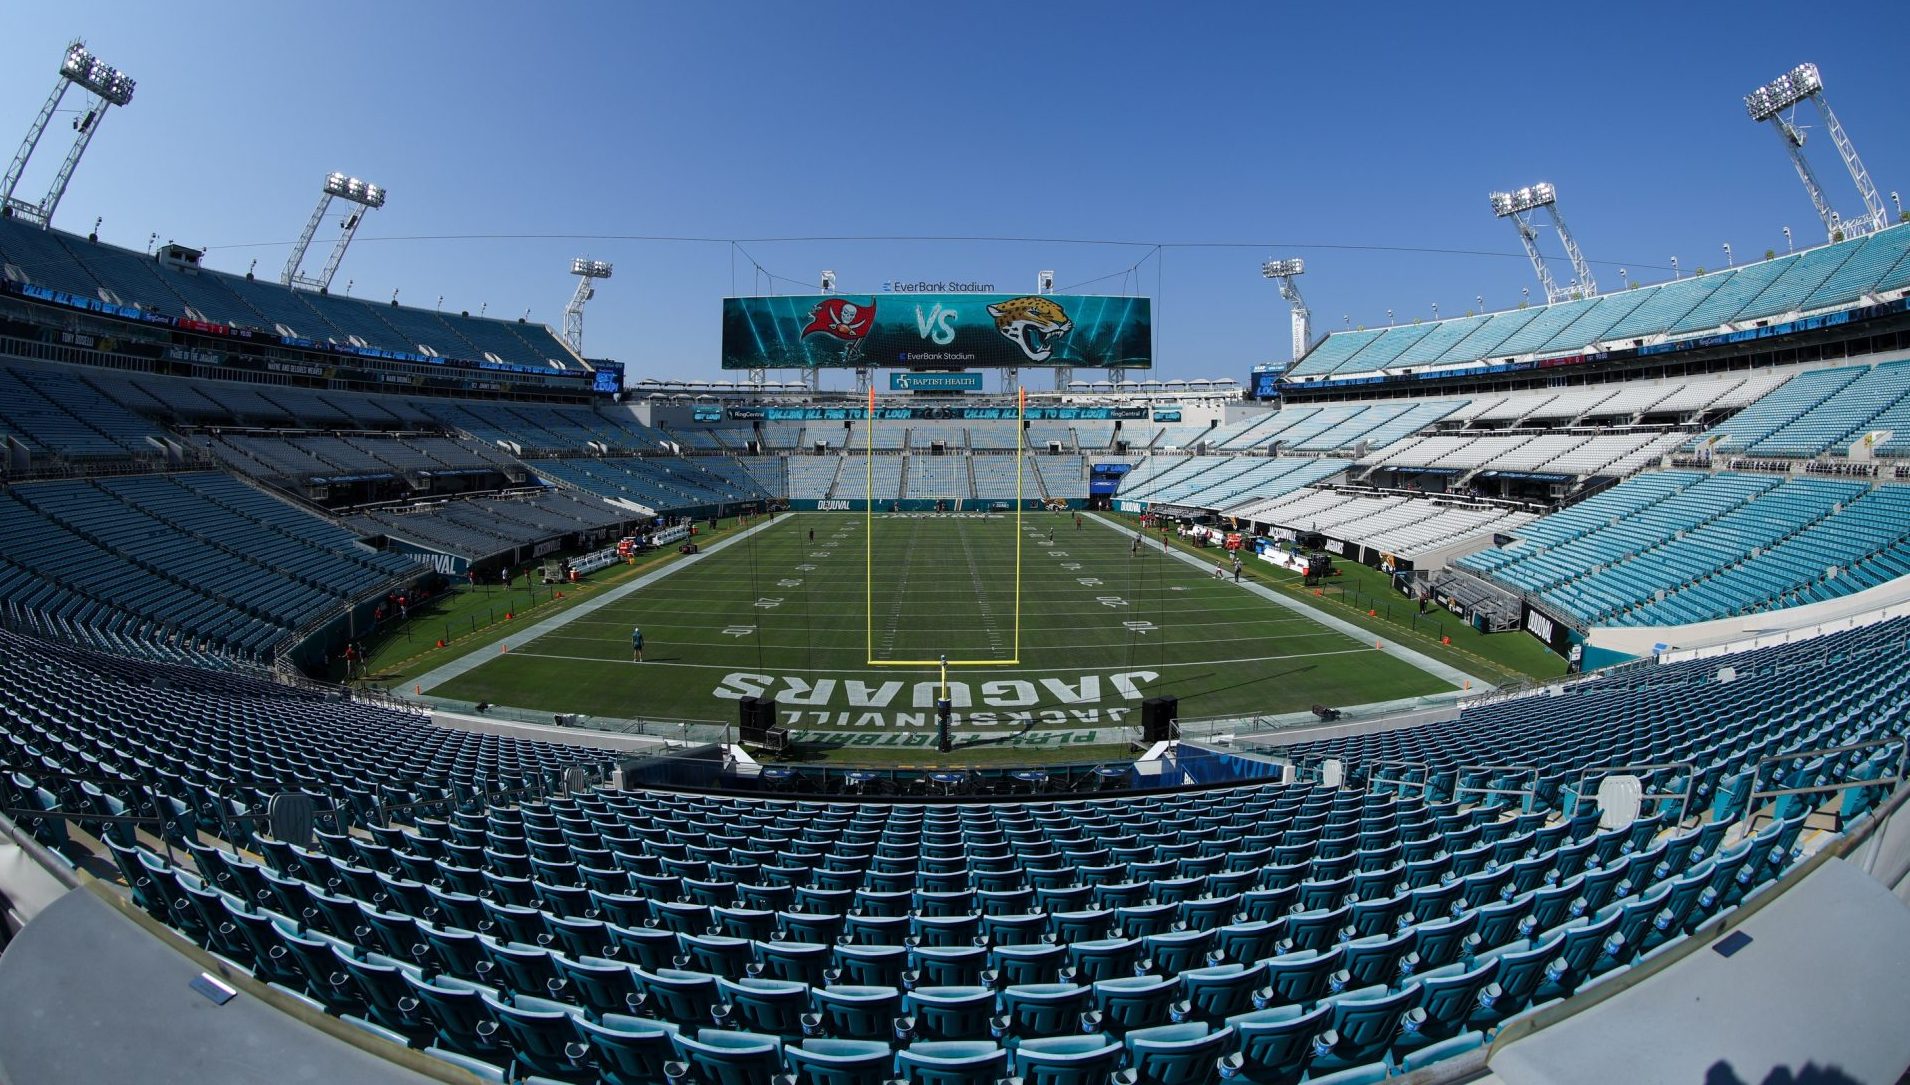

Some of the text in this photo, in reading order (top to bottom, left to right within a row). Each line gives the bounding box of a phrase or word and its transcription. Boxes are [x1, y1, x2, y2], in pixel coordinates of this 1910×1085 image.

[894, 282, 995, 292] EverBank Stadium
[915, 303, 958, 345] VS
[735, 411, 765, 419] RingCentral
[806, 410, 822, 419] ALL
[849, 410, 861, 419] TO
[964, 409, 999, 419] CALLING
[1002, 409, 1019, 418] ALL
[1045, 409, 1057, 419] TO
[1110, 411, 1140, 419] RingCentral
[713, 671, 1160, 707] JAGUARS
[780, 707, 1131, 727] JACKSONVILL
